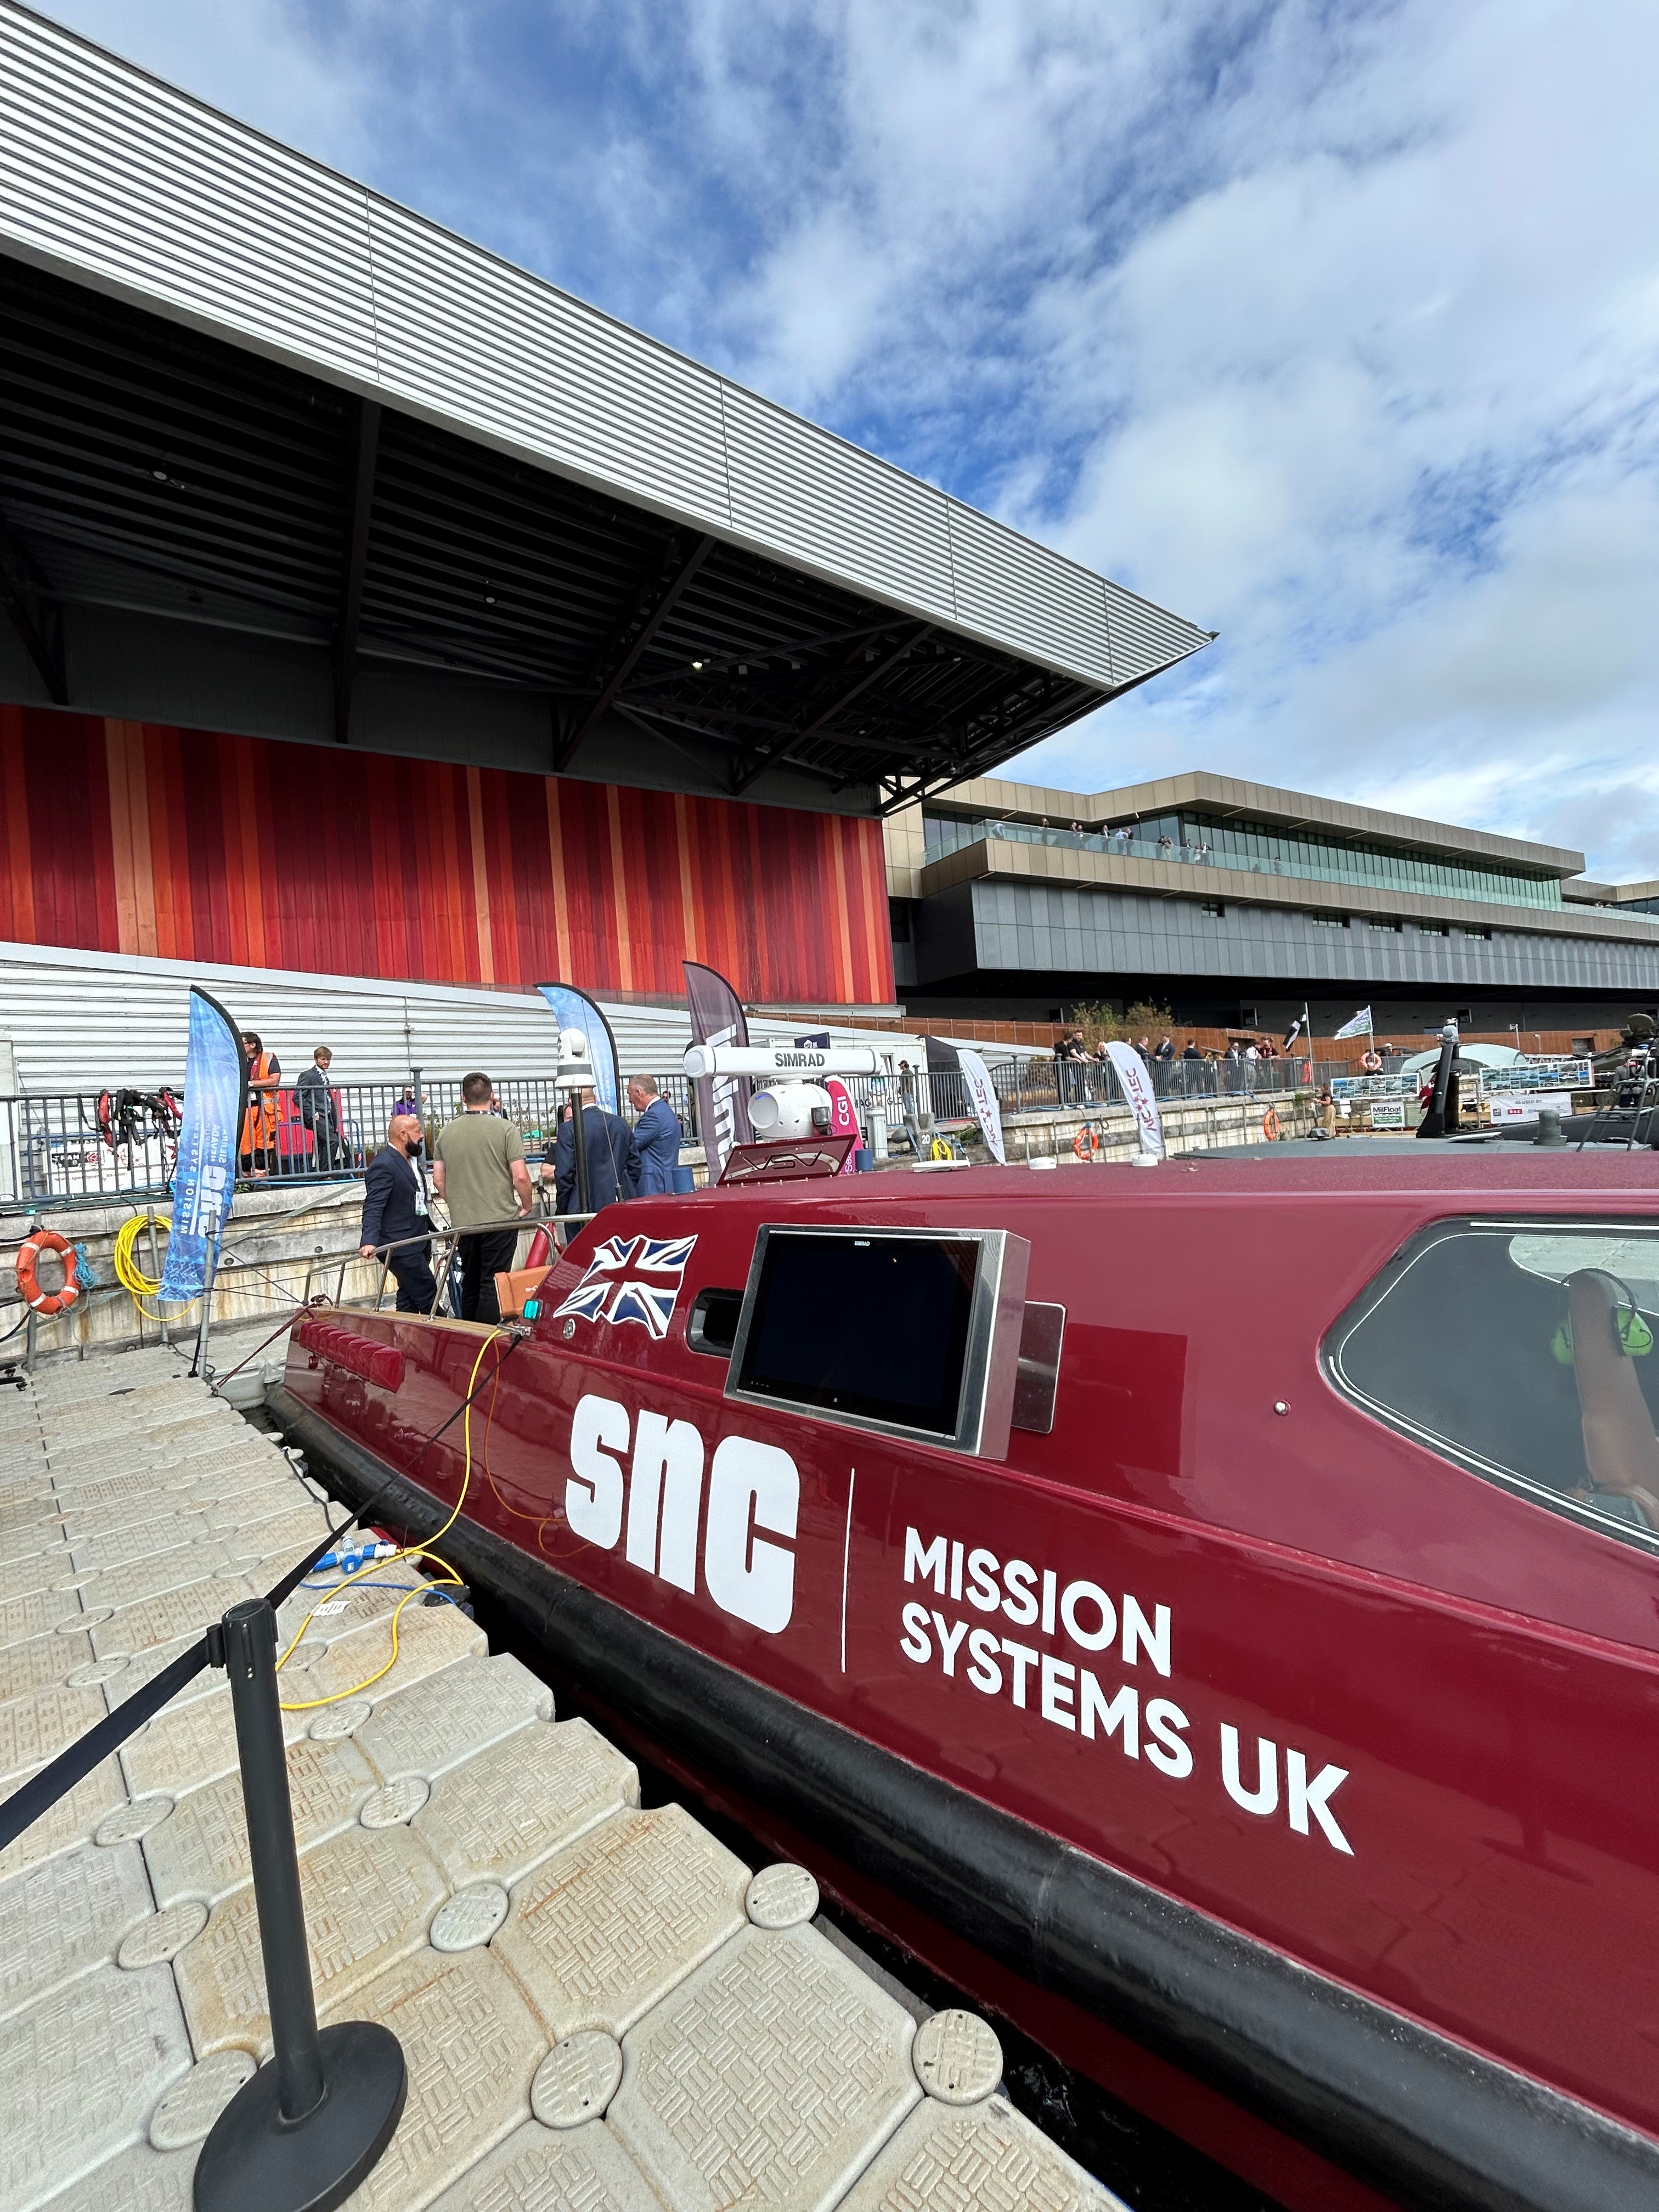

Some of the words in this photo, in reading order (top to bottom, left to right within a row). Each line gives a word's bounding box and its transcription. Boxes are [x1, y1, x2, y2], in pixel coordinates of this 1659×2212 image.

[775, 1053, 825, 1066] SIMRAD
[837, 1096, 850, 1126] CGI
[921, 1133, 930, 1144] 20
[902, 1527, 1172, 1678] MISSION
[899, 1601, 1194, 1779] SYSTEMS
[1220, 1722, 1355, 1856] UK
